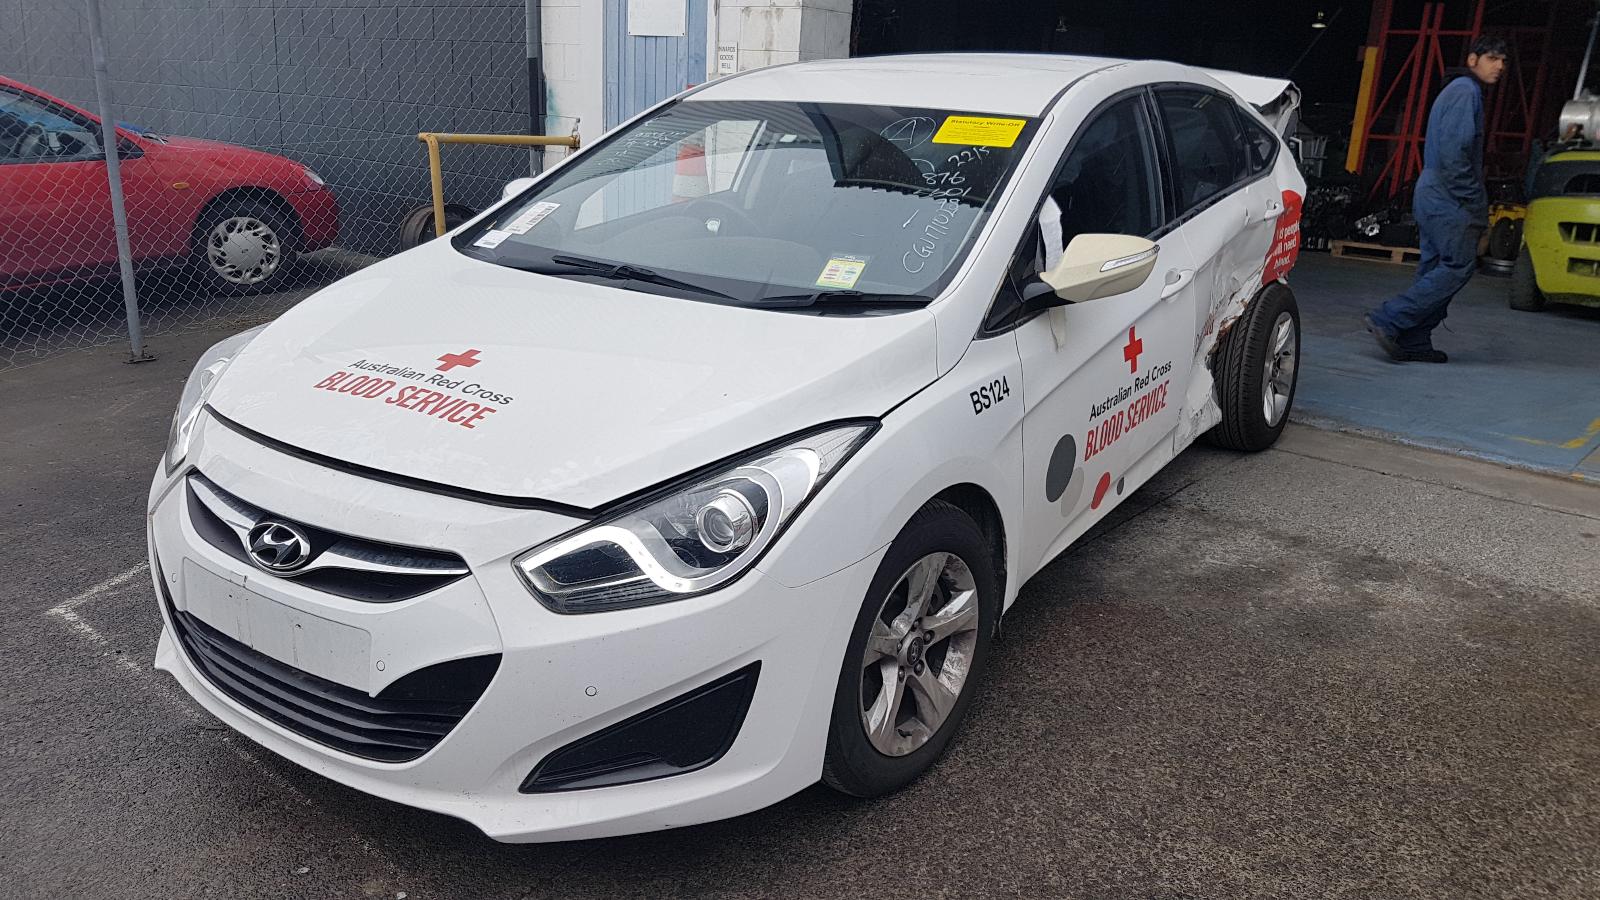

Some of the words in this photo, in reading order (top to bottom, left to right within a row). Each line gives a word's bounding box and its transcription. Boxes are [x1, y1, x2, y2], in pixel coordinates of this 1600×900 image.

[921, 171, 966, 186] 876
[312, 370, 398, 400] BLOOD
[384, 384, 498, 430] SERVICE
[347, 358, 425, 381] Australian
[424, 373, 465, 390] Red
[461, 382, 515, 406] Cross
[969, 375, 1010, 416] BS124
[1088, 385, 1133, 422] Australian
[1133, 369, 1151, 395] Red
[1150, 360, 1173, 382] Cross
[1083, 410, 1125, 462] BLOOD
[1124, 379, 1171, 434] SERVICE
